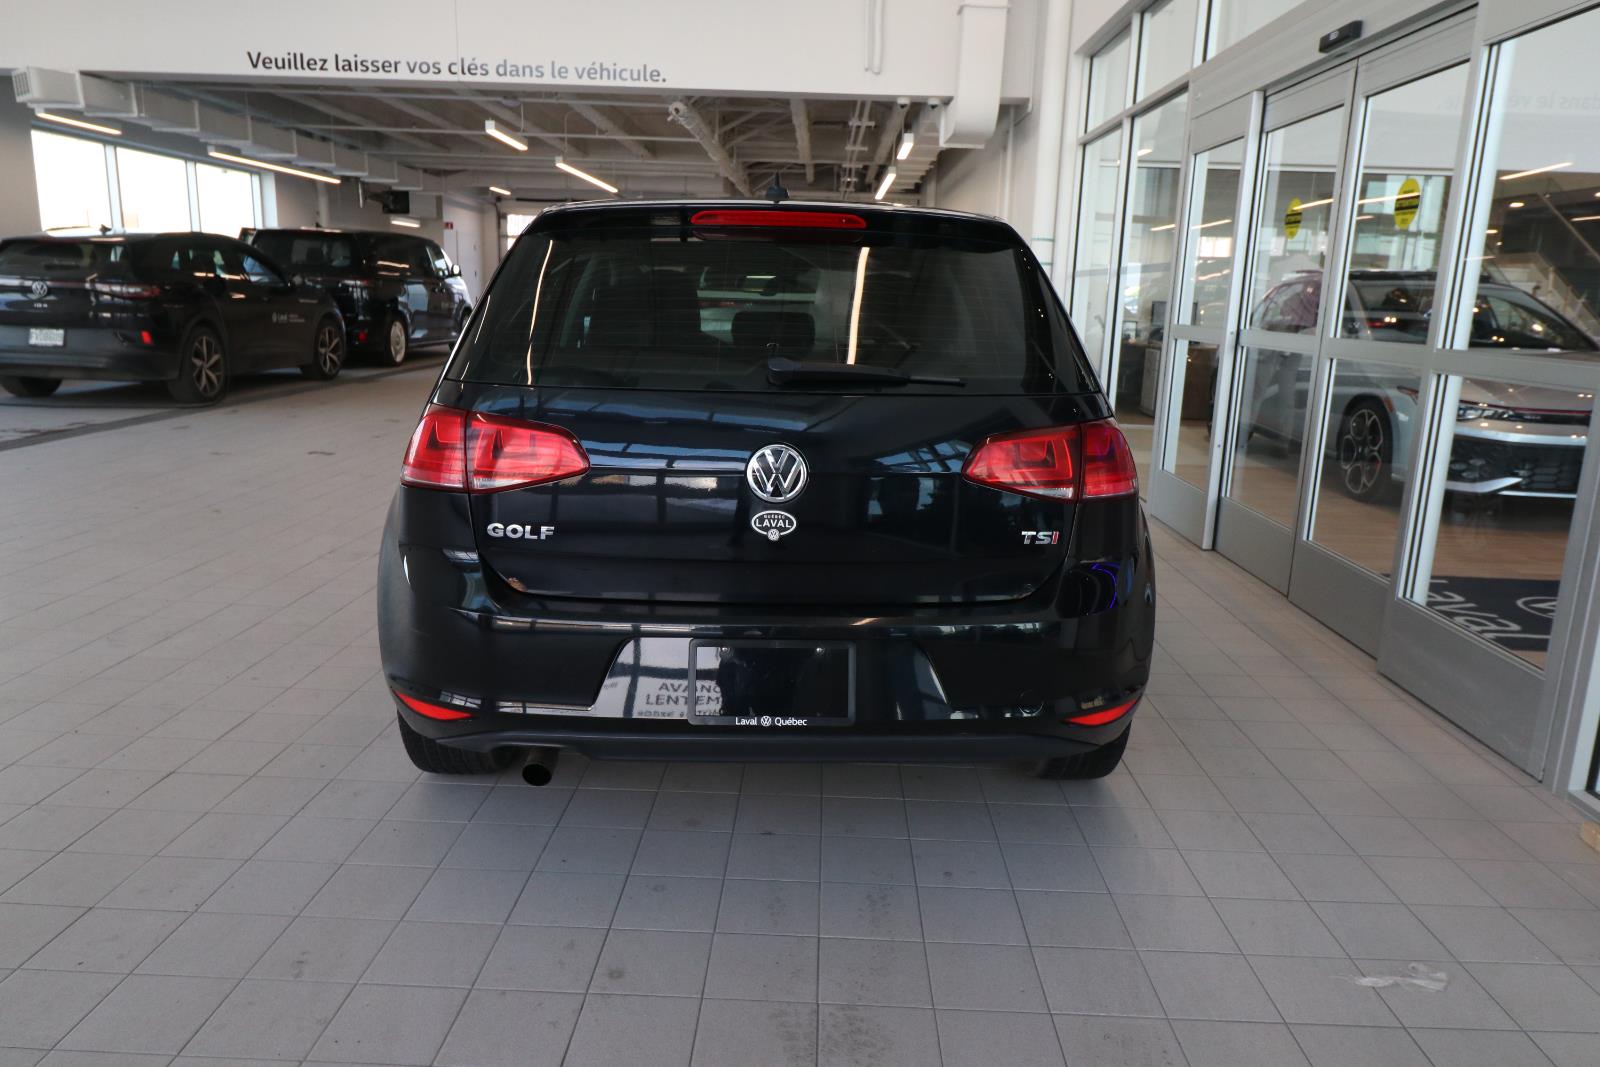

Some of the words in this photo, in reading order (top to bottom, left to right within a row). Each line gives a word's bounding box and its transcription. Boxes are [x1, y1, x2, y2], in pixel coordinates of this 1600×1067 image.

[247, 51, 329, 72] Veuillez
[334, 53, 401, 74] laisser
[406, 60, 442, 75] vos
[447, 57, 489, 76] clés
[495, 59, 545, 79] dans
[551, 60, 569, 79] le
[574, 62, 667, 83] véhicule.
[486, 522, 555, 540] GOLF
[755, 519, 792, 528] LAVAL
[1021, 530, 1060, 545] TSI
[735, 716, 758, 726] Laval
[774, 717, 808, 727] Québec
